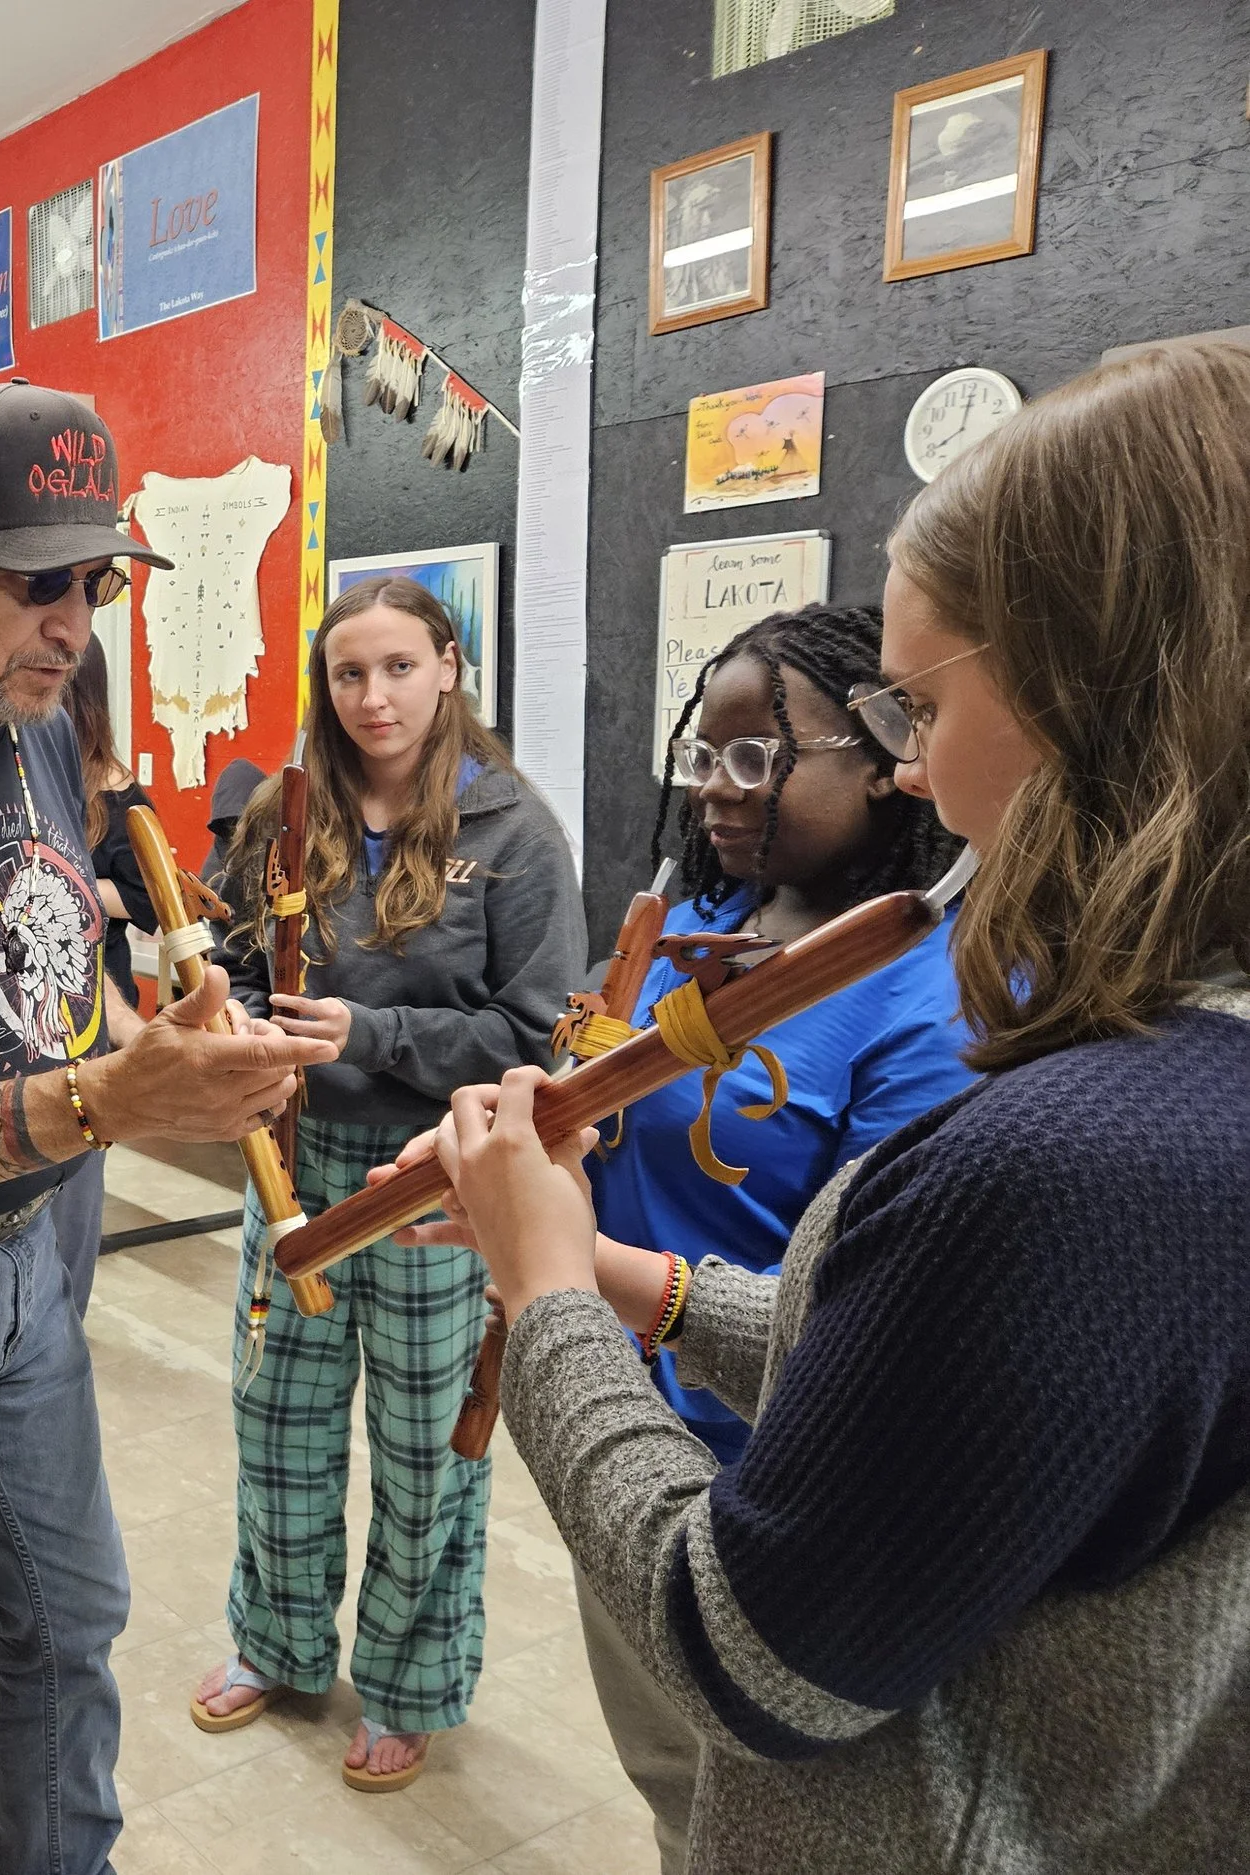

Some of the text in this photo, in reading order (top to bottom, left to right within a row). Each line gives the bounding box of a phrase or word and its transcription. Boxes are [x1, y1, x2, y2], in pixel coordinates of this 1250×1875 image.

[149, 188, 219, 247] Love
[158, 302, 170, 312] The
[945, 388, 988, 407] 11 1
[961, 382, 977, 399] 12
[930, 399, 1002, 422] 10 2
[922, 425, 933, 438] 9
[51, 428, 106, 467] WILD
[925, 443, 936, 458] 8
[707, 553, 781, 572] learn some
[705, 578, 788, 609] LAKOTA
[666, 639, 719, 663] Pleas
[1, 811, 26, 839] died
